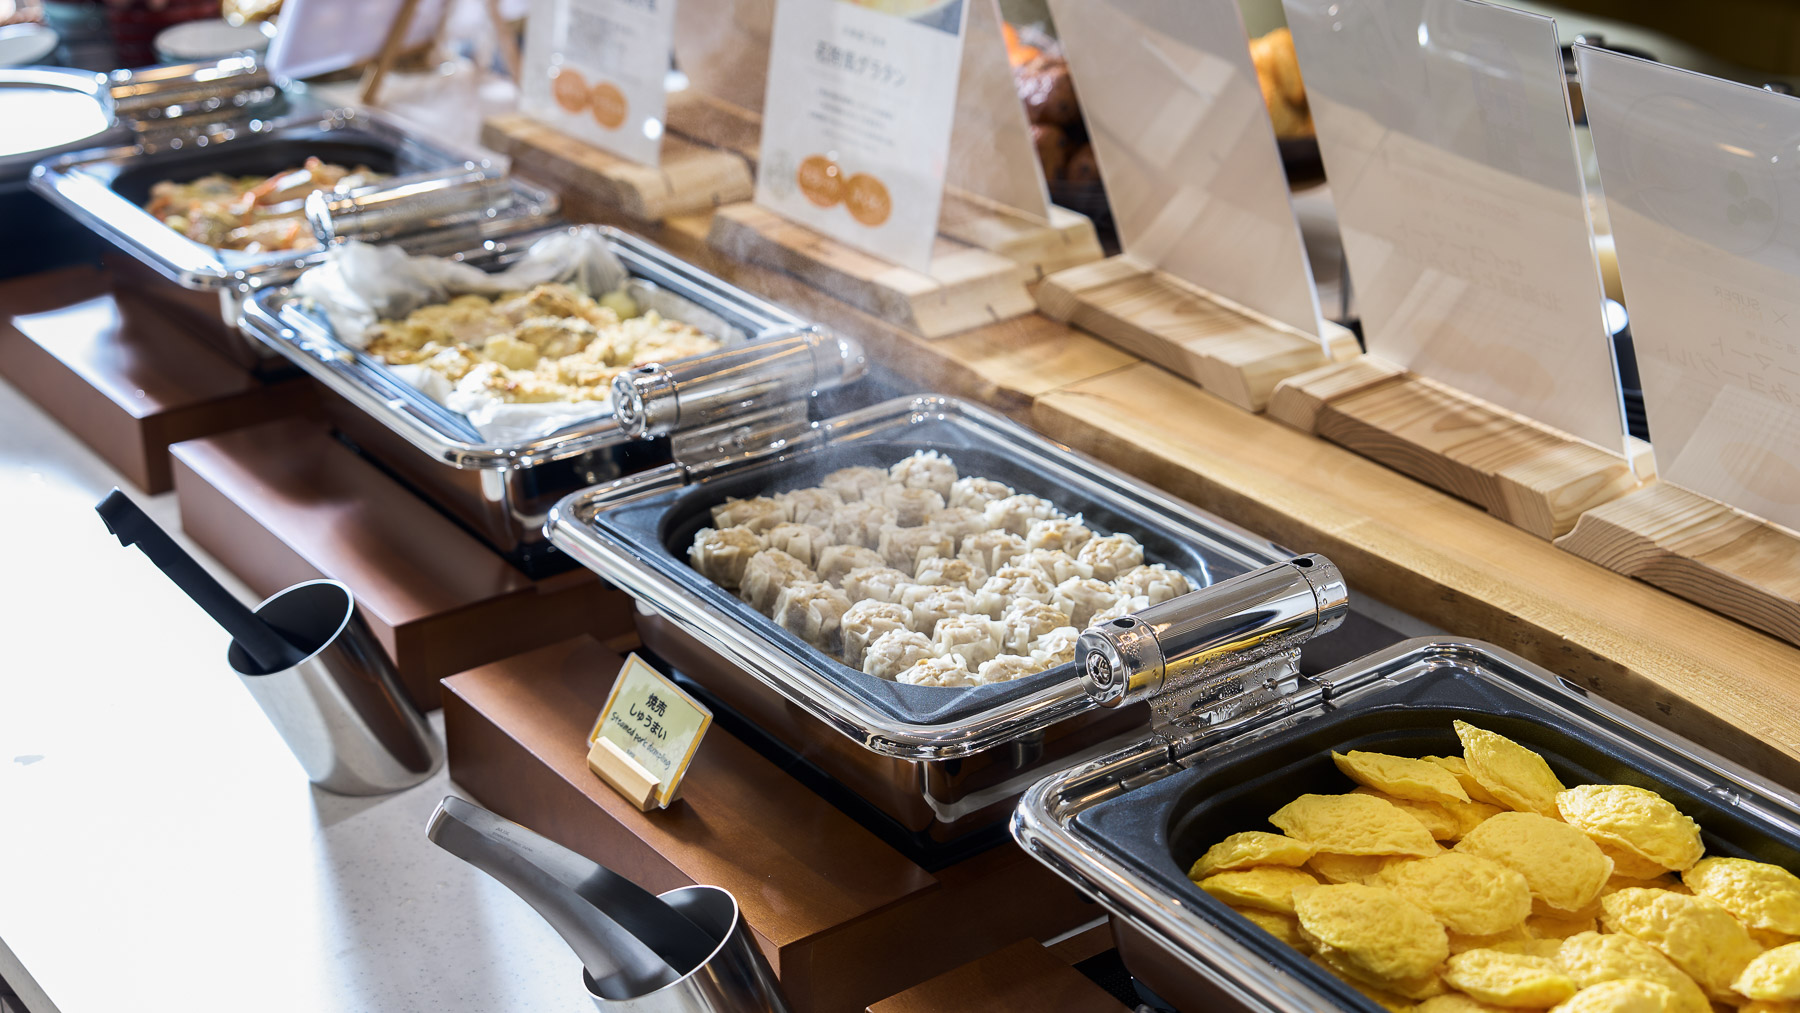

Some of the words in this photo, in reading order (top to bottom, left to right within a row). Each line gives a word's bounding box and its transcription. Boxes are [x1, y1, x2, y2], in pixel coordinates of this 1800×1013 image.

[645, 692, 668, 717] 焼売
[611, 711, 636, 736] Steamed
[629, 702, 667, 740] しゅうまい
